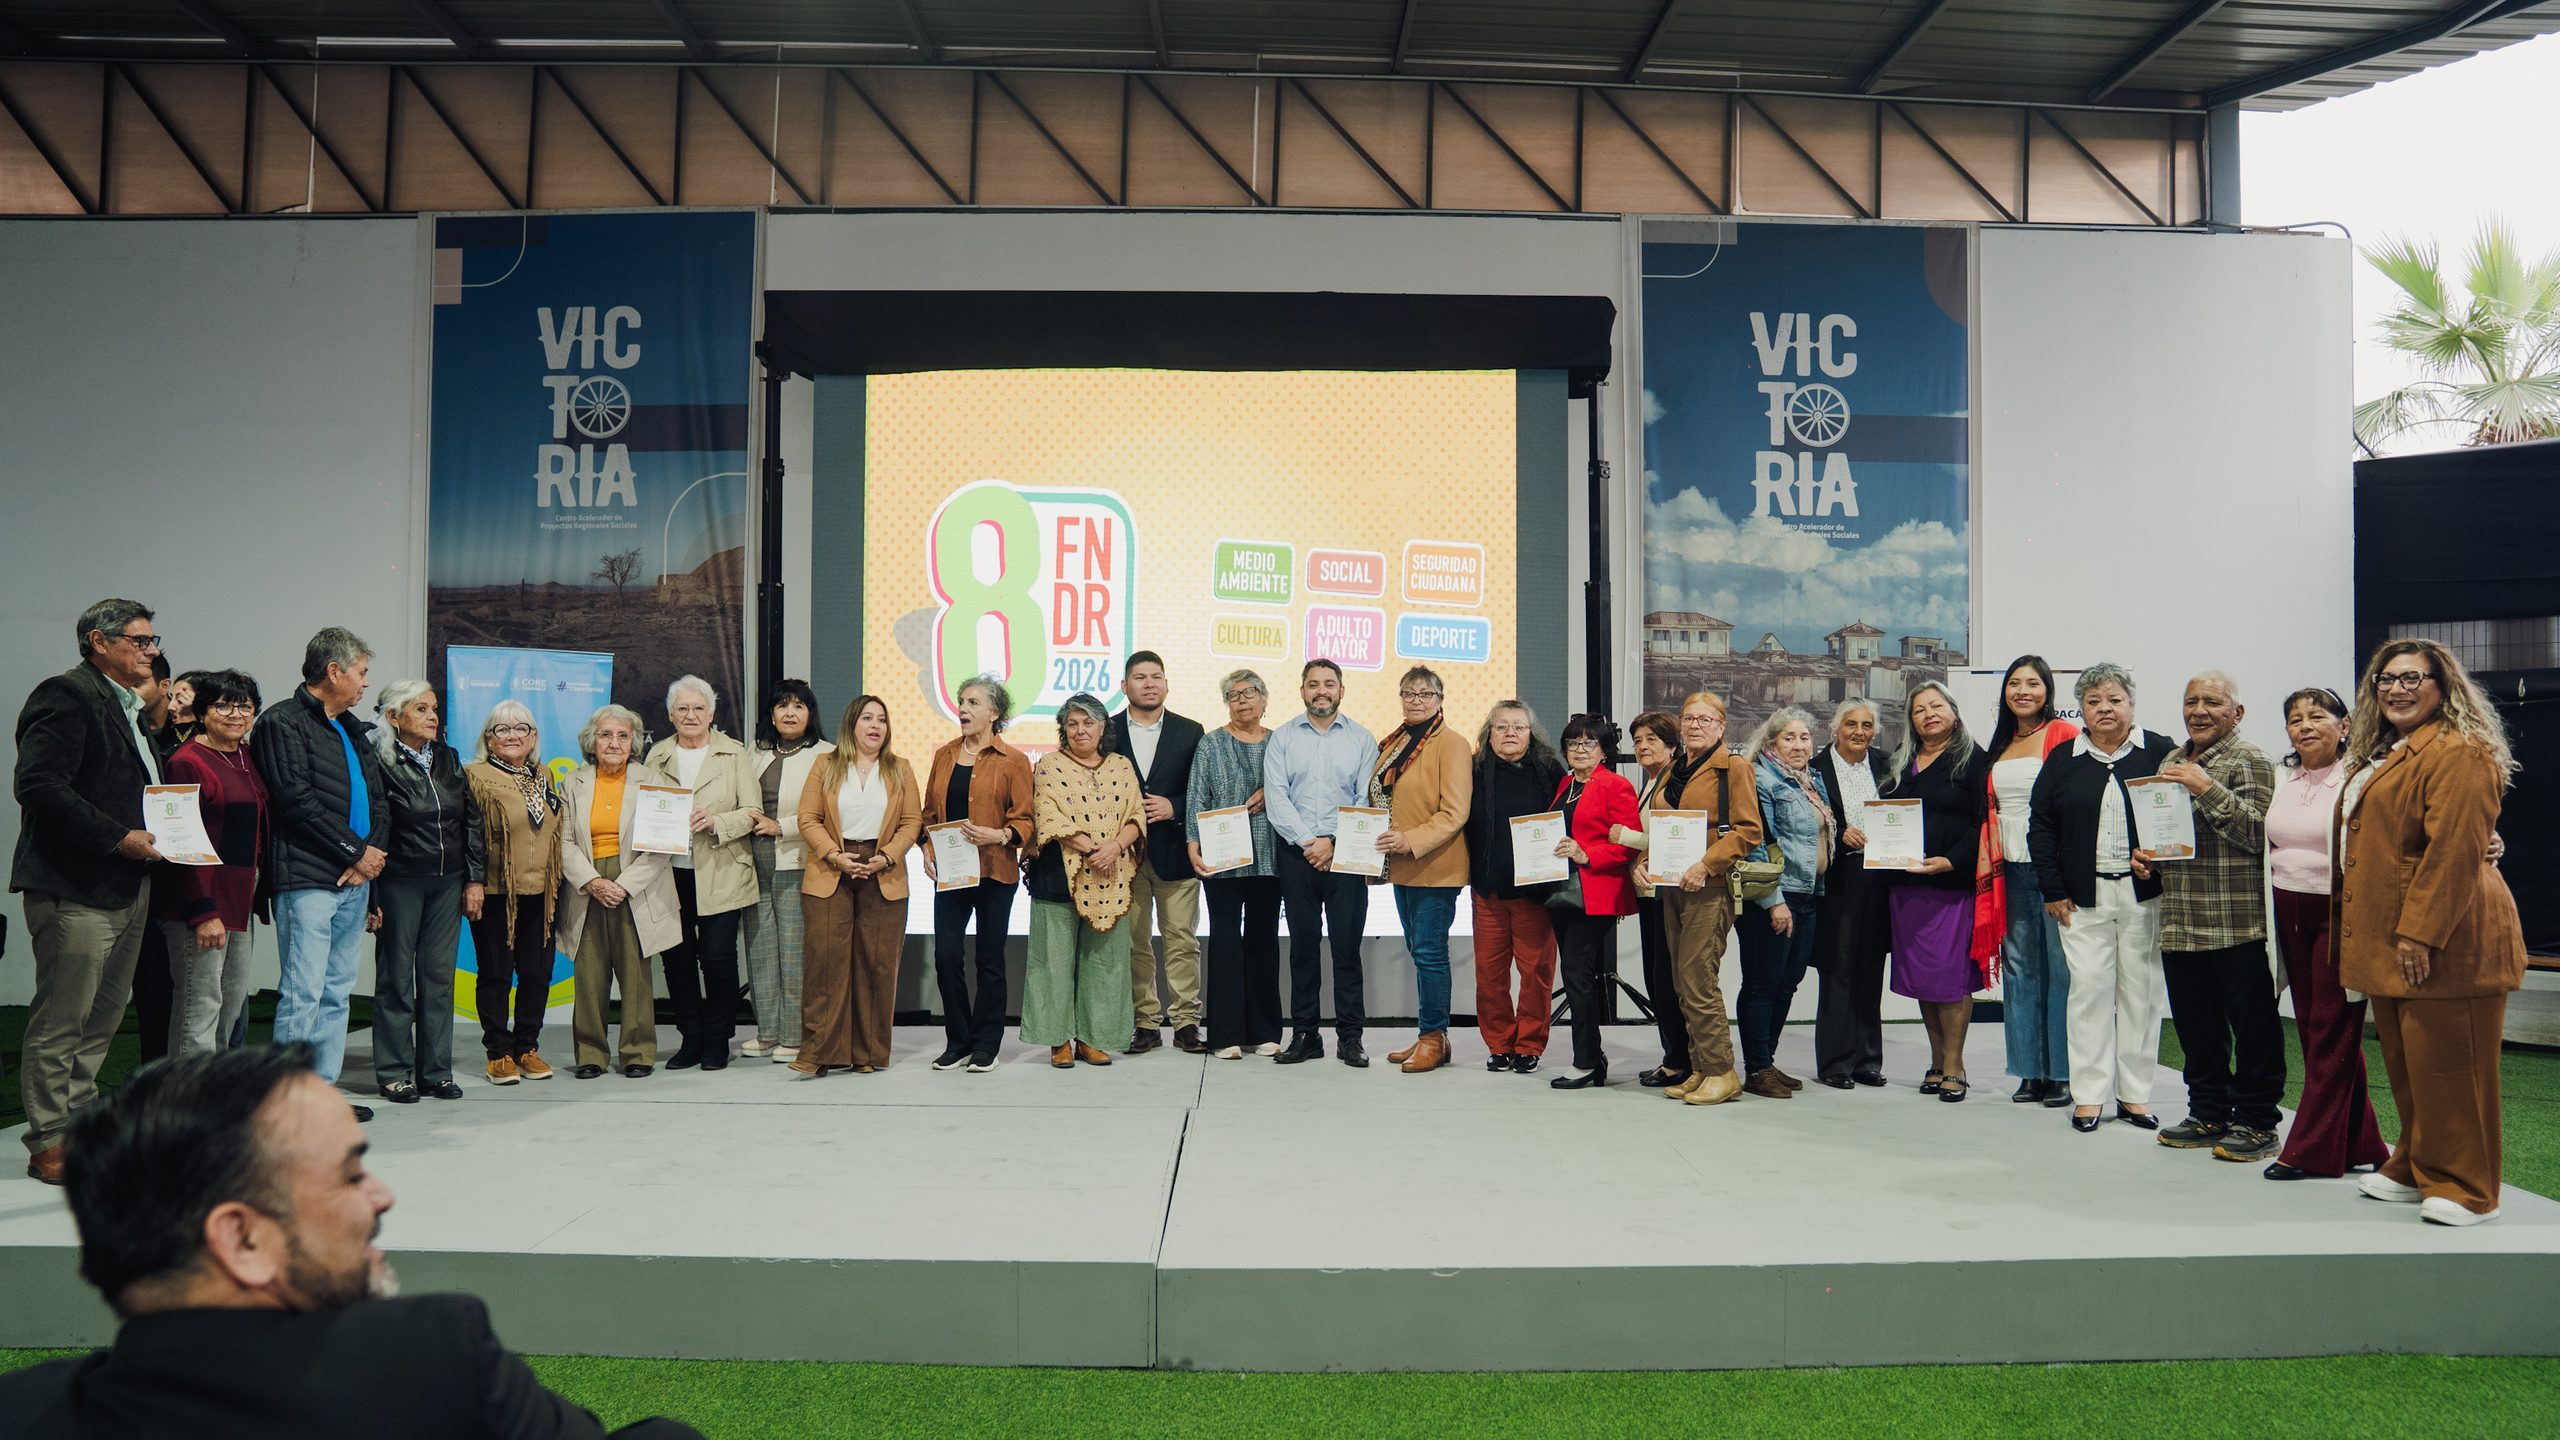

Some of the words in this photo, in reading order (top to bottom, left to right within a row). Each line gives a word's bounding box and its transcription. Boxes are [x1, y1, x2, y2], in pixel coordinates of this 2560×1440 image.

[540, 522, 573, 531] Proyectos
[574, 522, 609, 531] Regionales
[555, 514, 577, 522] Centro
[578, 514, 612, 522] Acelerador
[1799, 523, 1834, 531] Acelerador
[1836, 523, 1845, 531] de
[1832, 531, 1860, 539] Sociales
[1055, 516, 1112, 581] FN
[1233, 549, 1276, 571] MEDIO
[1320, 560, 1373, 584] SOCIAL
[1412, 553, 1476, 574] SEGURIDAD
[1219, 570, 1289, 595] AMBIENTE
[1410, 573, 1476, 593] CIUDADANA
[931, 485, 1046, 718] 8
[1053, 582, 1111, 647] DR
[1217, 624, 1283, 648] CULTURA
[1315, 615, 1372, 640] ADULTO
[1411, 624, 1478, 650] DEPORTE
[1317, 636, 1369, 661] MAYOR
[1053, 657, 1111, 692] 2026
